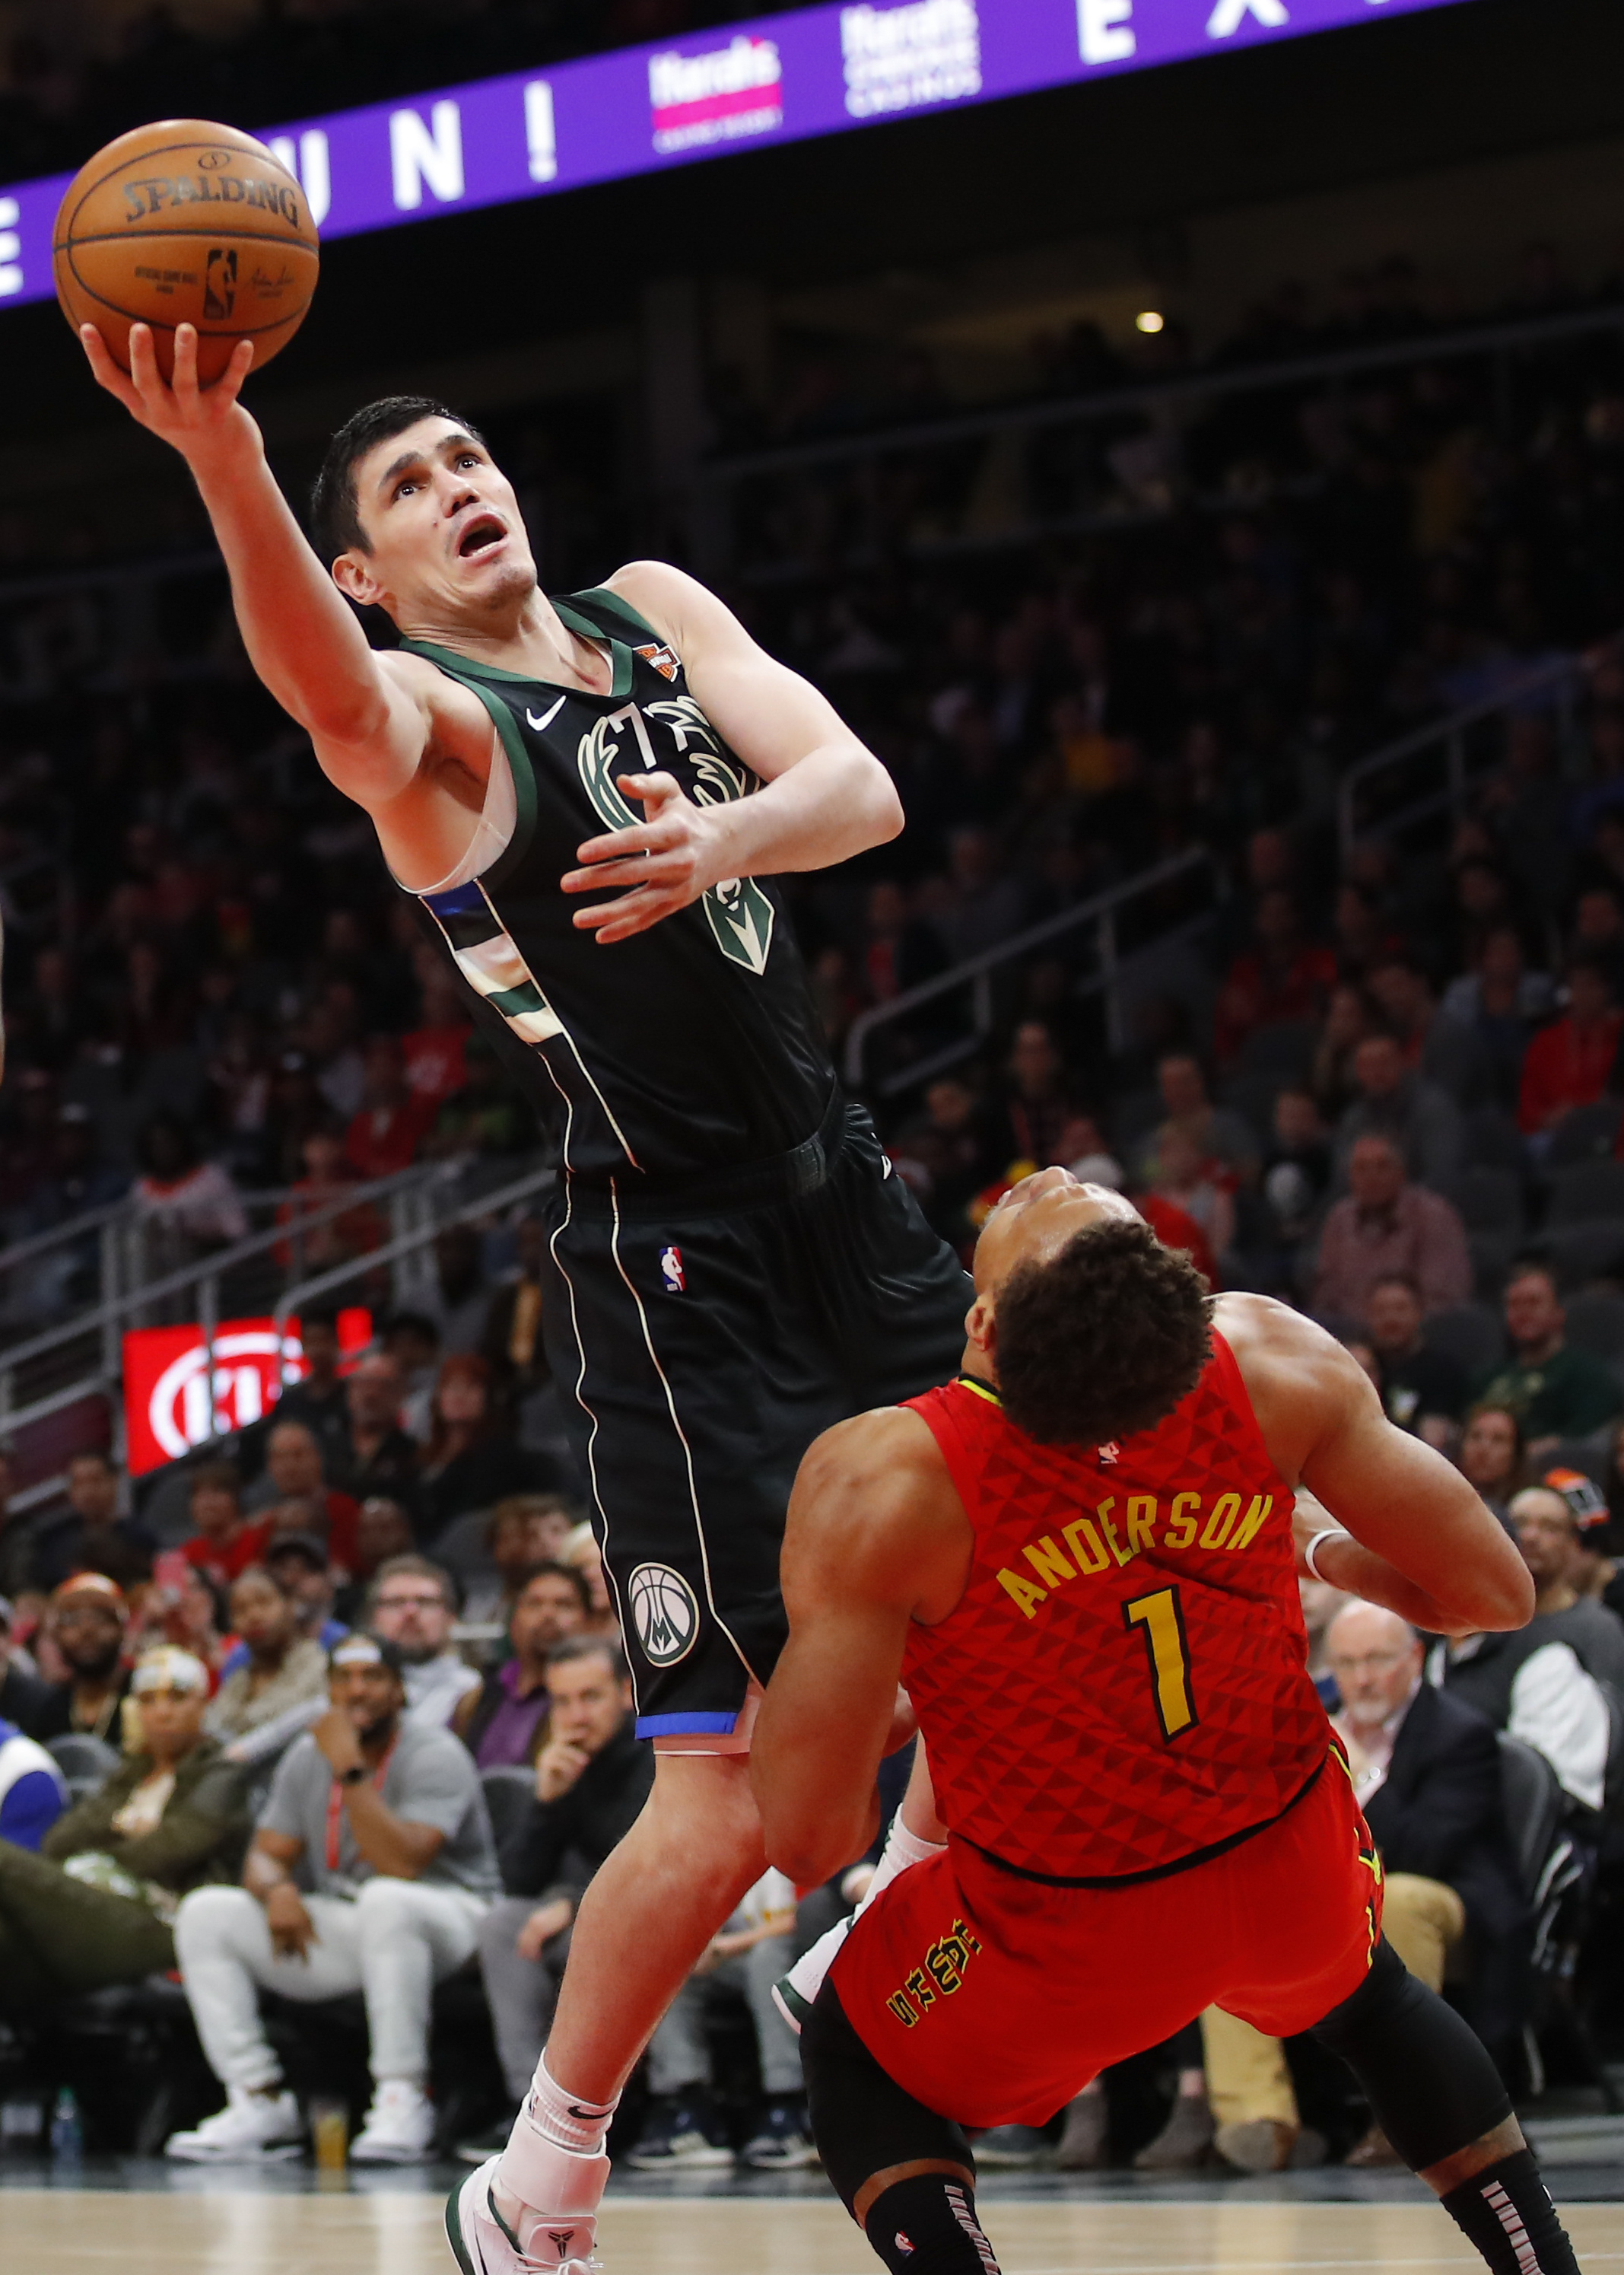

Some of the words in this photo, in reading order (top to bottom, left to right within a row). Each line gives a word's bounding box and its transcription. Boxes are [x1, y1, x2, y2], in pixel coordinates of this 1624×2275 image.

[124, 176, 299, 228] SPALDING
[996, 1491, 1273, 1619] ANDERSON
[1120, 1583, 1200, 1745] 1
